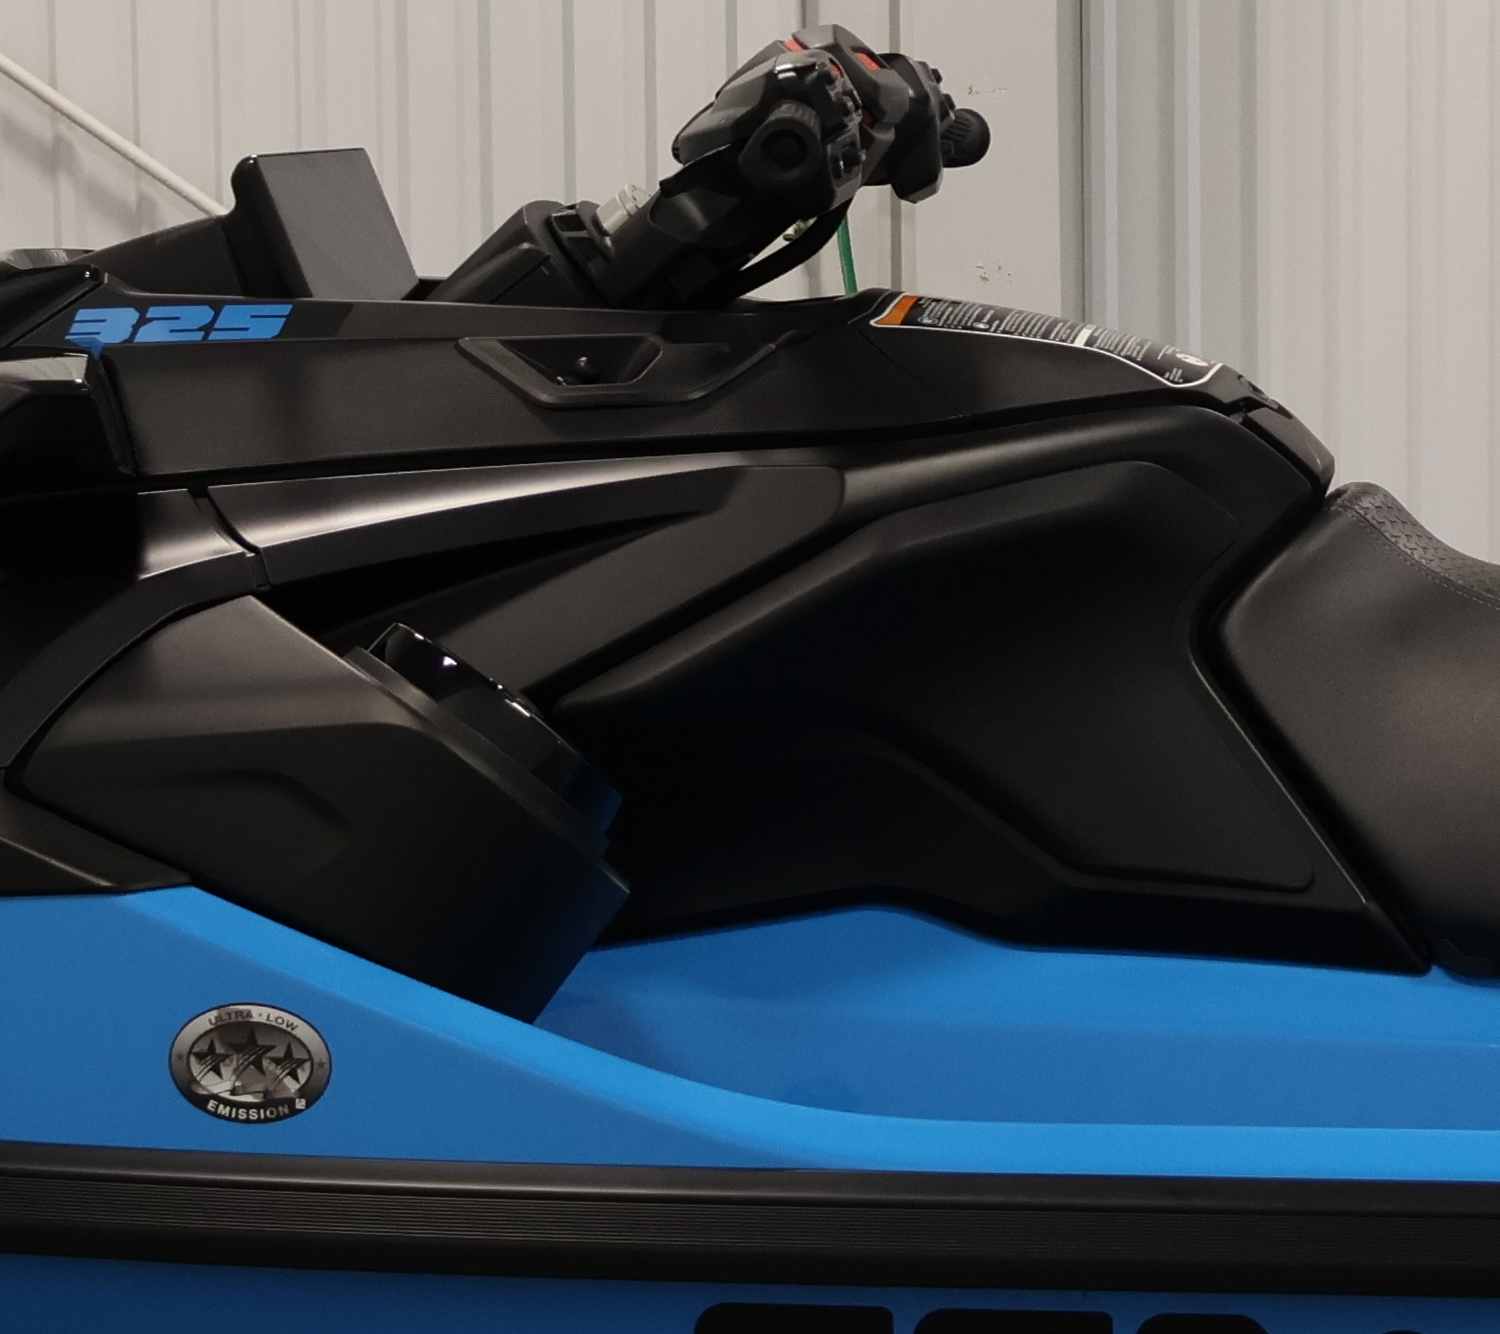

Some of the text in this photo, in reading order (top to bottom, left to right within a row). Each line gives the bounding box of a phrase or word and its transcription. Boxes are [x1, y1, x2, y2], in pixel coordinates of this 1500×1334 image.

[208, 1009, 299, 1032] ULTRA LOW
[206, 1099, 290, 1121] EMISSION
